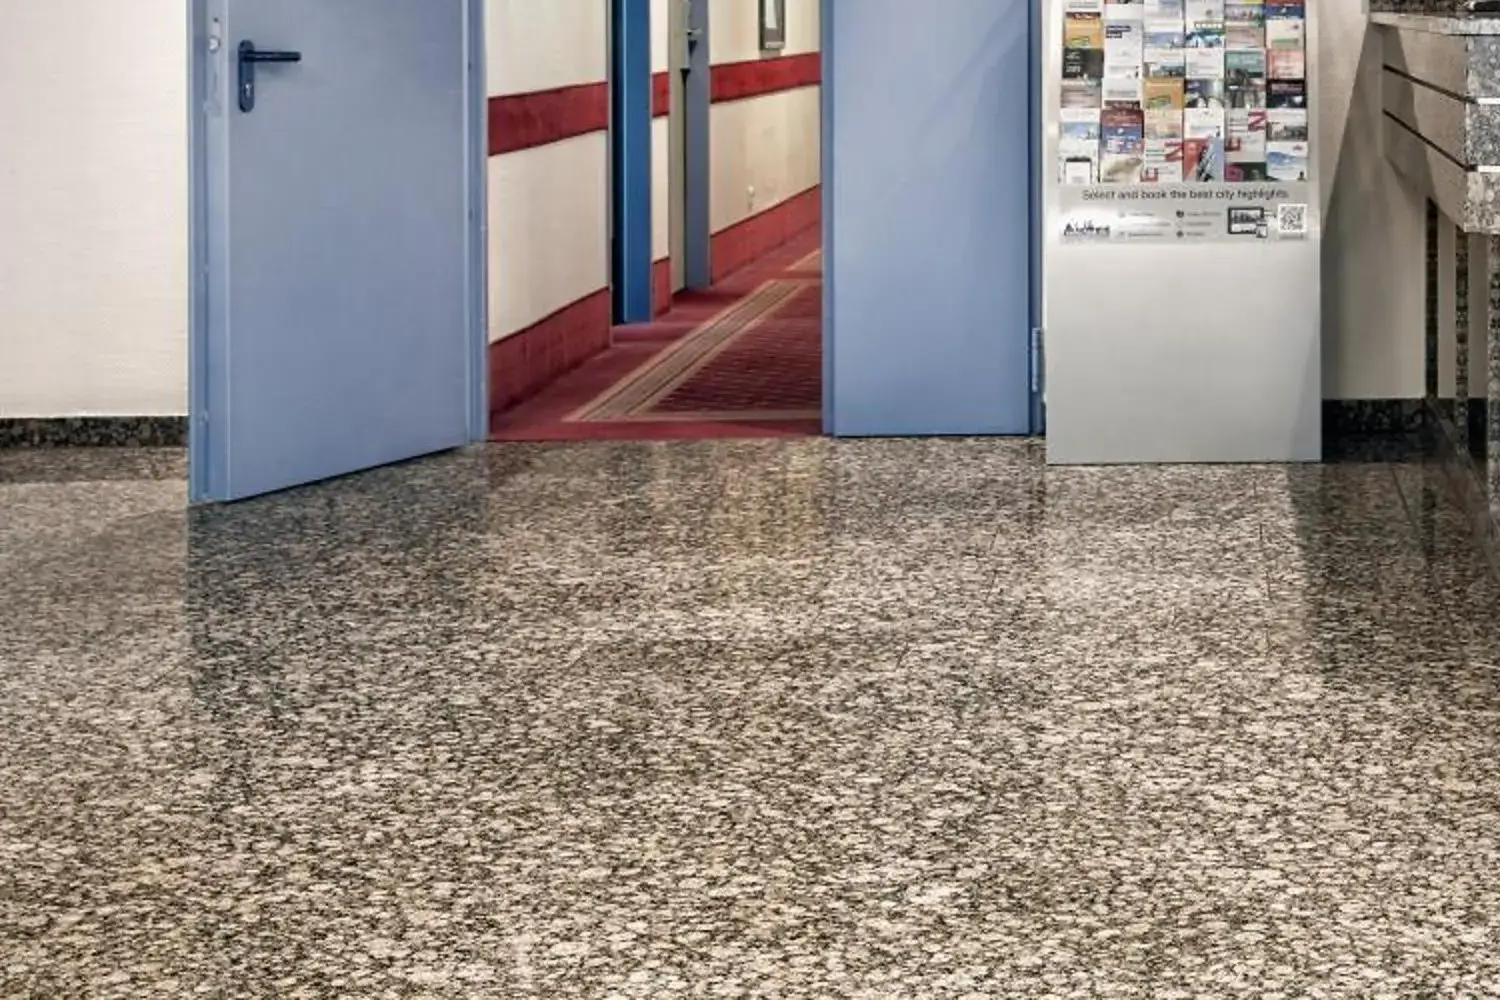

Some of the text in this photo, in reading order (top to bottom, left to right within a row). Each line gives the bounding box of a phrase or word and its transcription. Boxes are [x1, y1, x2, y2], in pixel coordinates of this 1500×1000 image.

[1082, 189, 1115, 201] Select
[1118, 190, 1139, 201] and
[1141, 189, 1168, 201] book
[1170, 189, 1188, 200] the
[1189, 189, 1213, 201] best
[1216, 189, 1234, 202] city
